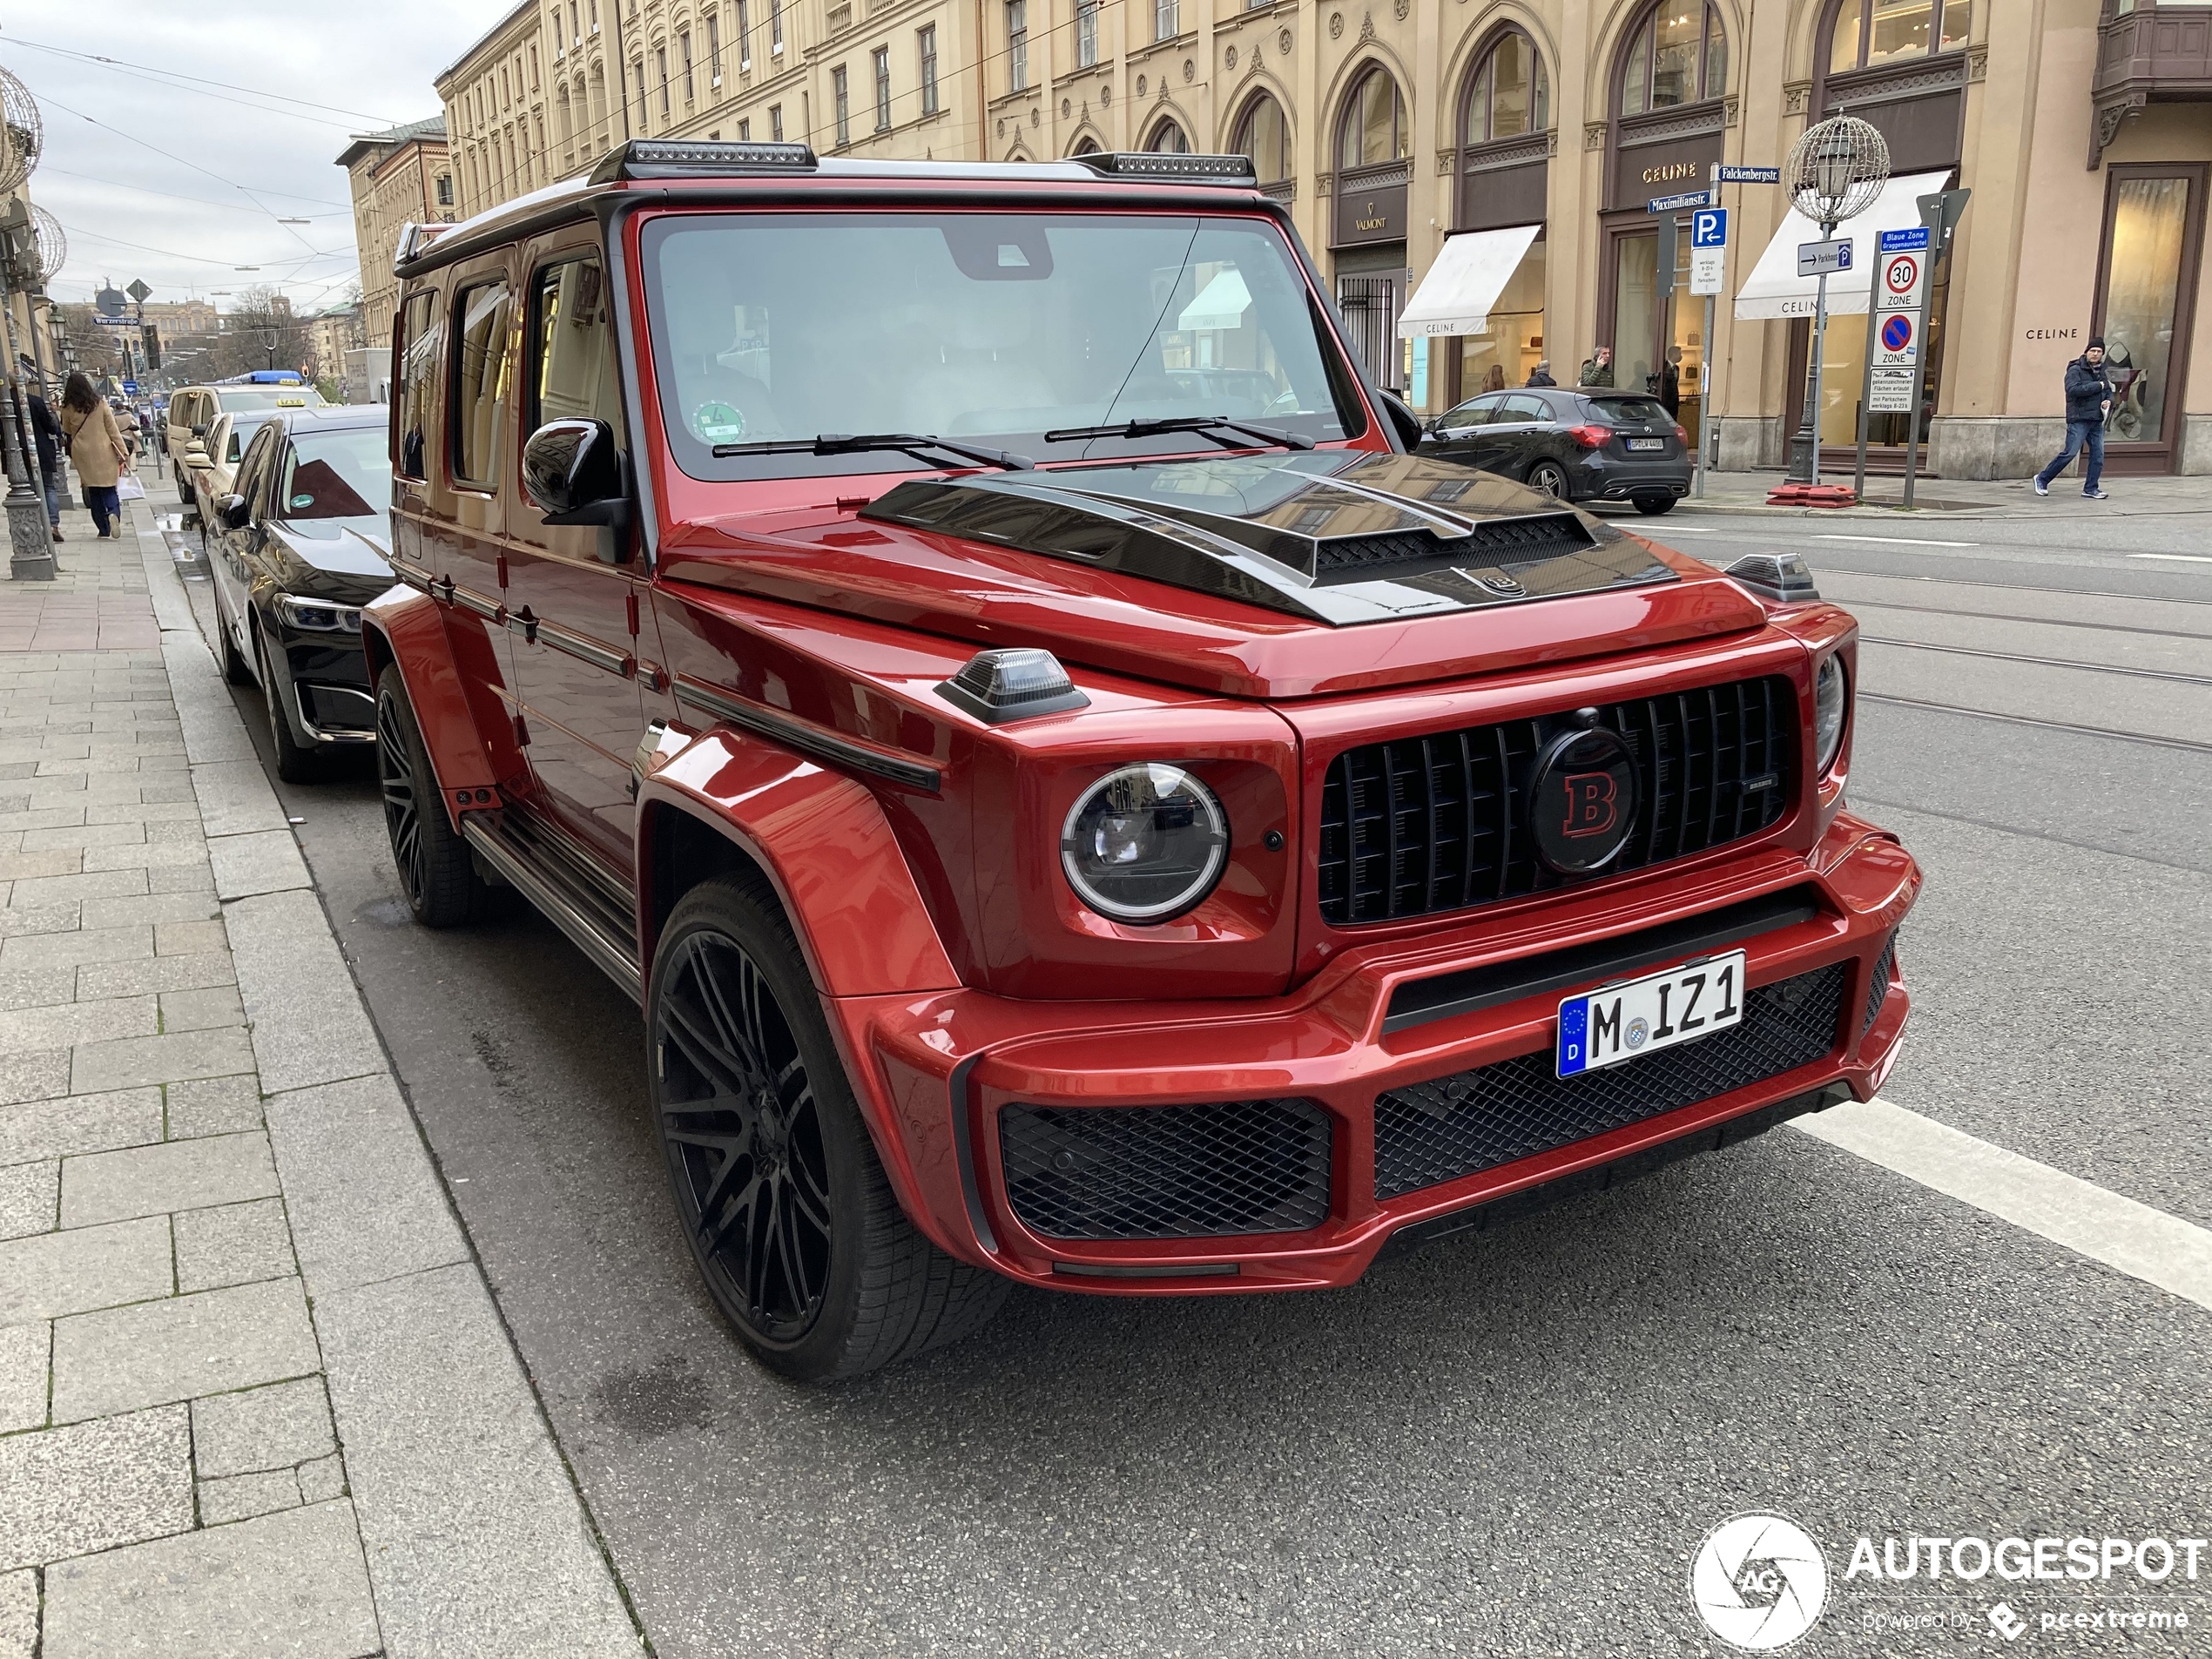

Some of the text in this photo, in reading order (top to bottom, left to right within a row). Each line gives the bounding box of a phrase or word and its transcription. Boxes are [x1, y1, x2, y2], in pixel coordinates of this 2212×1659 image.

[1642, 162, 1696, 184] CELINE
[1722, 167, 1777, 183] Falckenbergstr.
[1652, 193, 1706, 212] Maximilianstr.
[1356, 218, 1386, 231] VALMONT
[1697, 214, 1717, 244] P
[1907, 231, 1924, 239] Zone
[1882, 239, 1926, 249] Graggenauviertel
[1817, 253, 1838, 263] Parkhaus
[1892, 266, 1911, 284] 30
[1782, 300, 1826, 314] CELIN
[1888, 295, 1912, 306] ZONE
[95, 317, 138, 326] Wurzerstraße
[1426, 323, 1454, 334] CELINE
[2026, 328, 2077, 340] CELINE
[1883, 354, 1906, 363] ZONE
[712, 407, 725, 424] 4
[1562, 772, 1617, 838] B
[1592, 996, 1622, 1058] M
[1568, 1043, 1579, 1061] D
